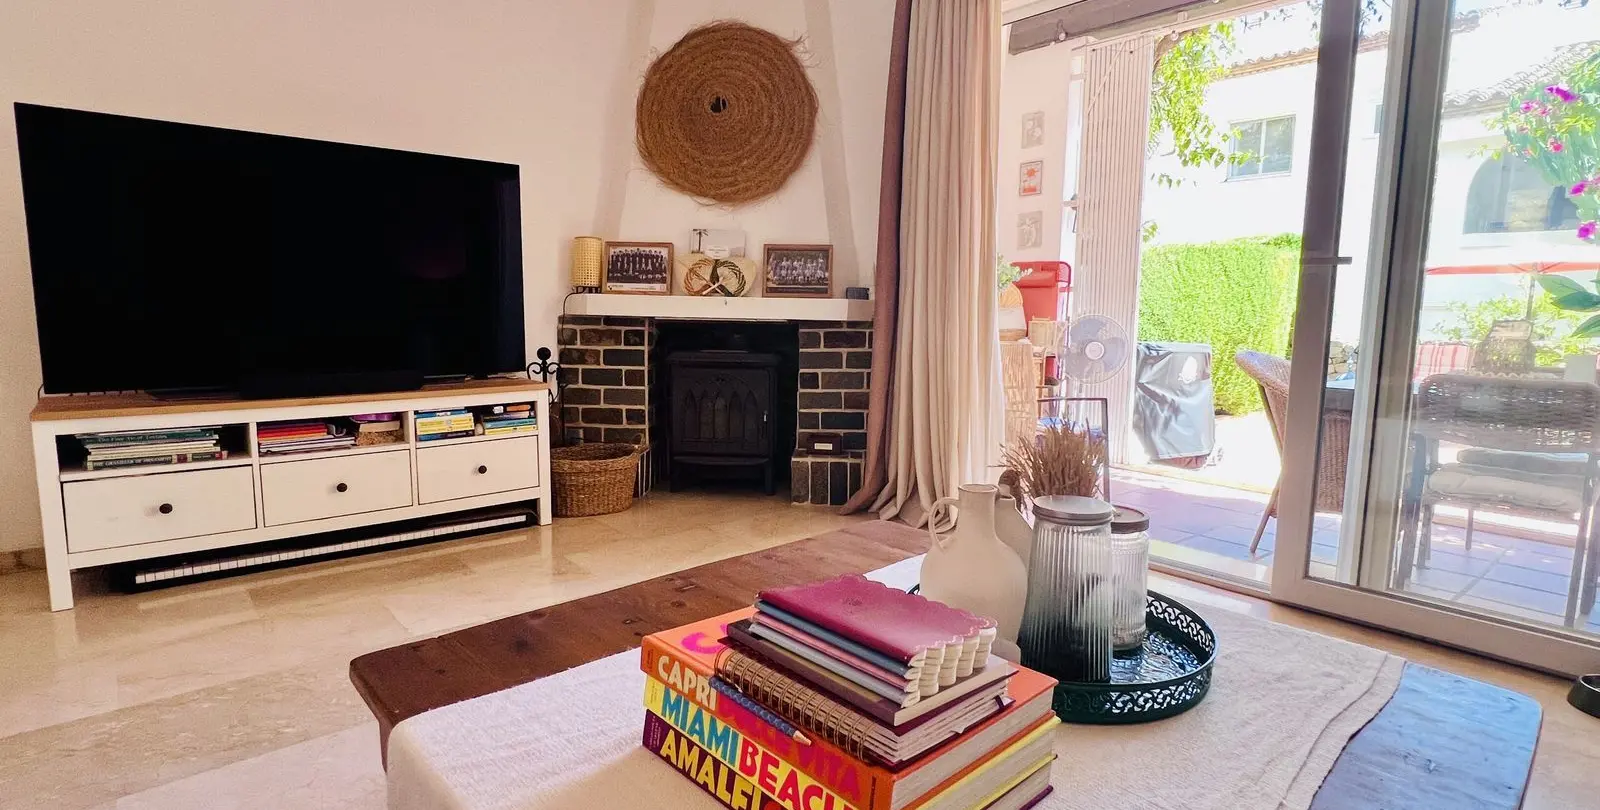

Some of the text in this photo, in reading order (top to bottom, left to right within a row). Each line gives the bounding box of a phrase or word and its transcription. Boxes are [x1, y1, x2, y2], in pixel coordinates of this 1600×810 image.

[658, 655, 717, 711] CAPRI
[661, 686, 740, 767] MIAMI
[660, 728, 762, 810] AMALFI
